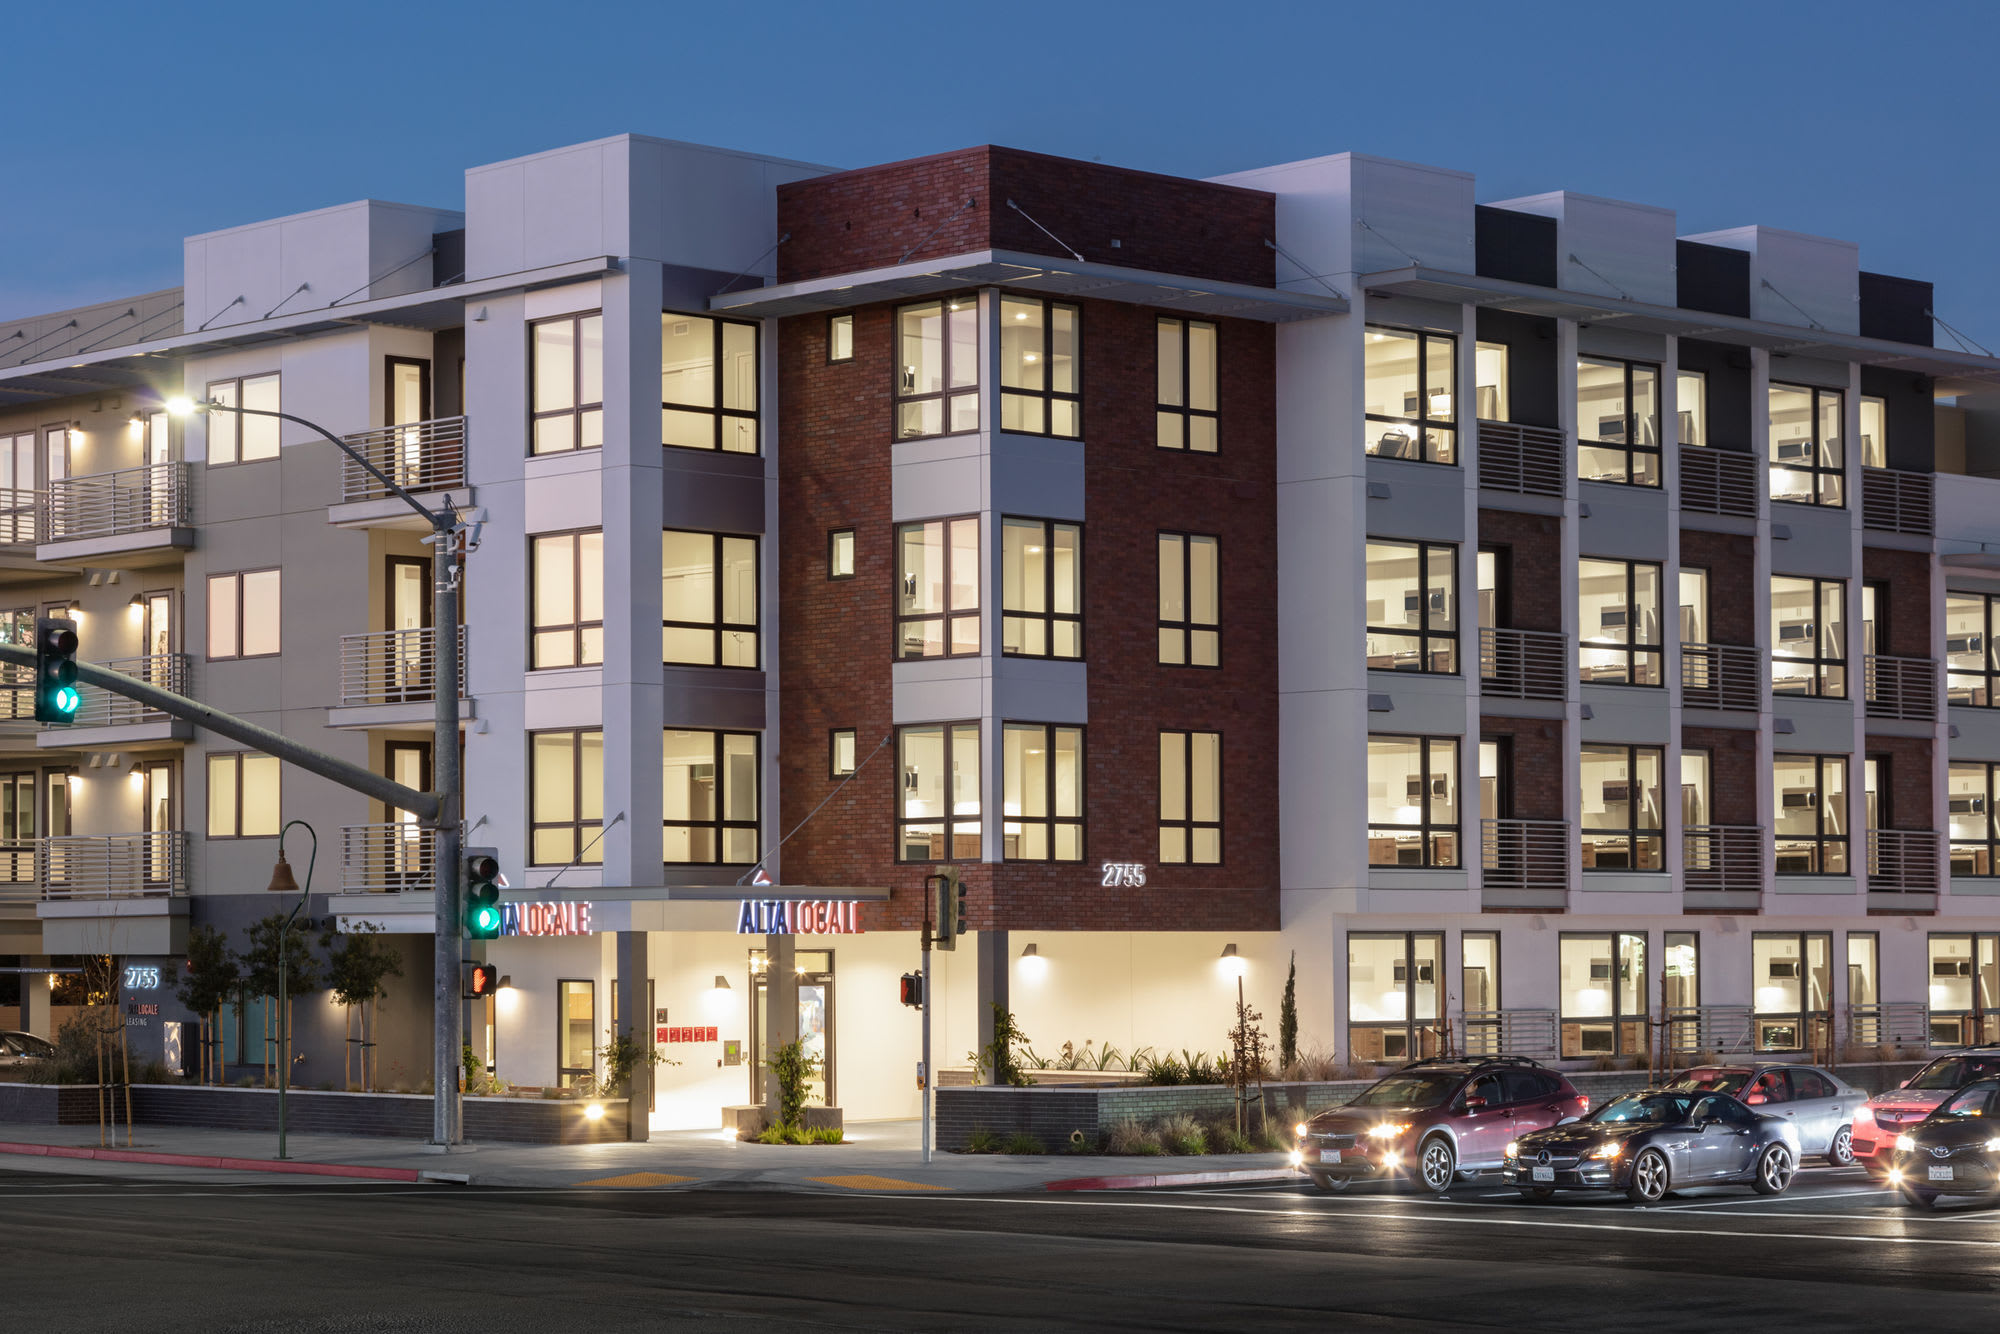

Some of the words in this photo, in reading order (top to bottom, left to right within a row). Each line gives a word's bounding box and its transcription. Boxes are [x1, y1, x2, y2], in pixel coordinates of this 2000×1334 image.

[1102, 863, 1147, 888] 2755
[498, 901, 592, 936] TALOCALE
[124, 967, 160, 989] 2755
[126, 1017, 147, 1026] LEASING
